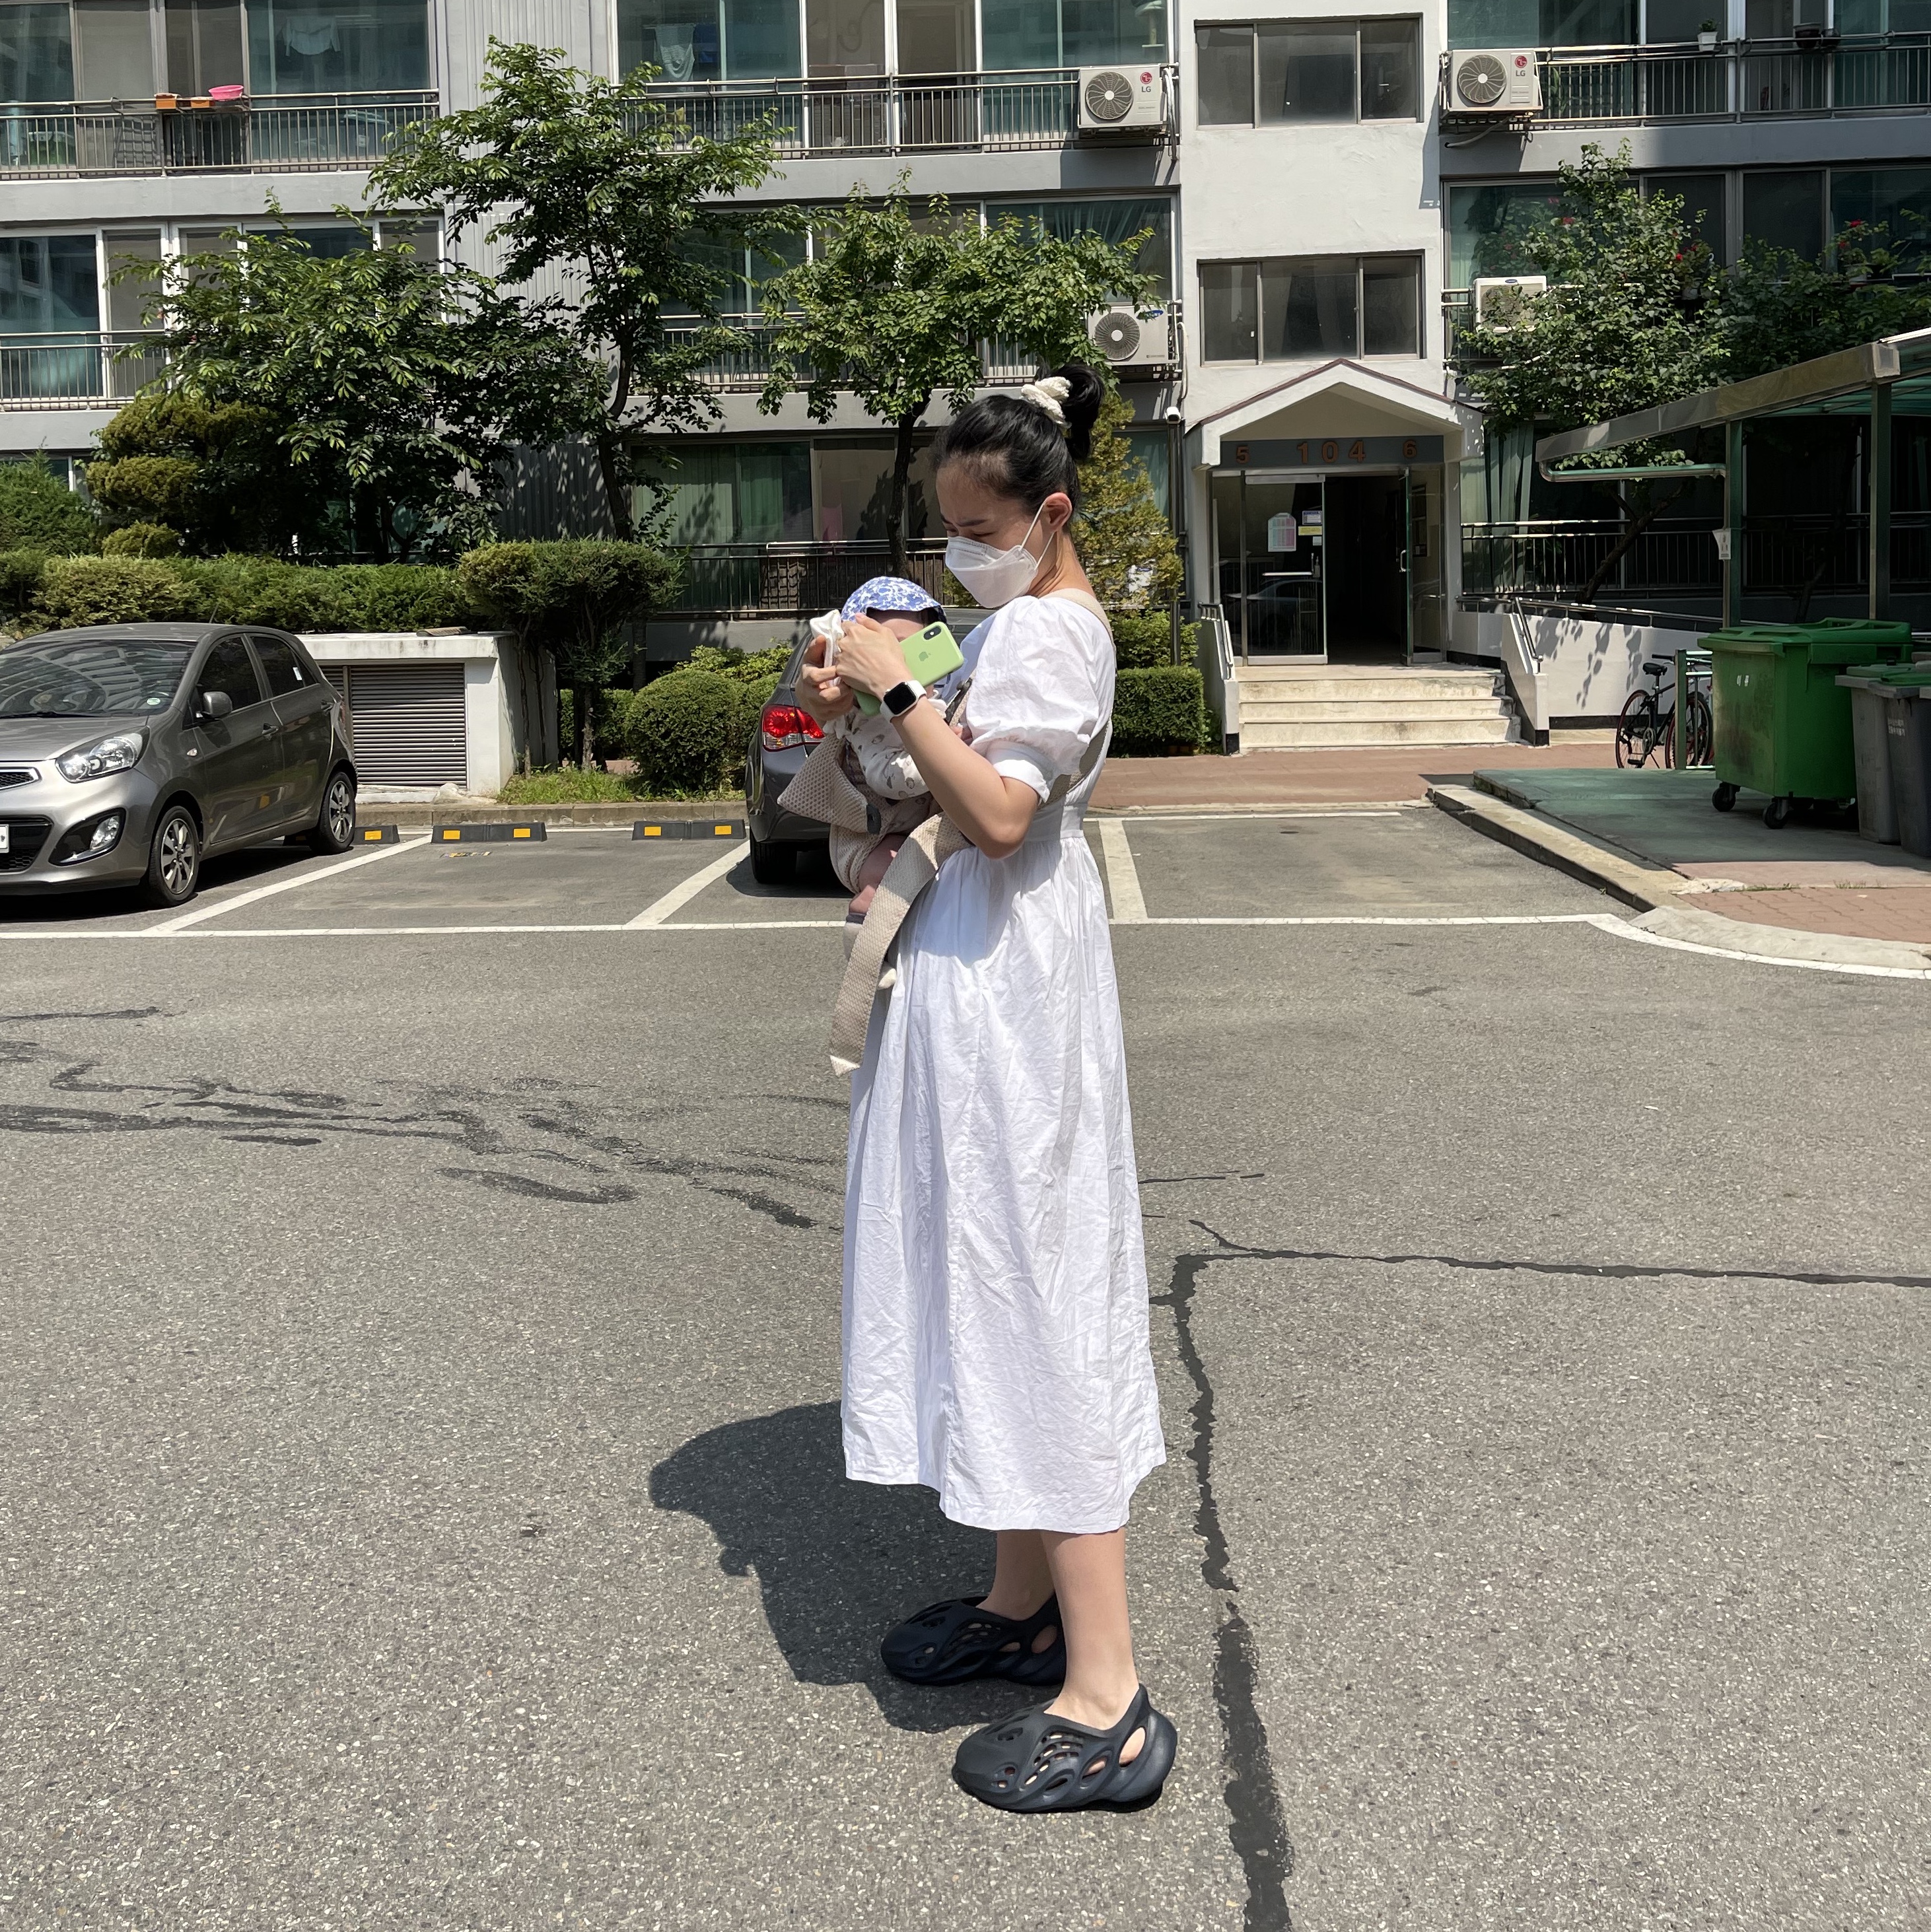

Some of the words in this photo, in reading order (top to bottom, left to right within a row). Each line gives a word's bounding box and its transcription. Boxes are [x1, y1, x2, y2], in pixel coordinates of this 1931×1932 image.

[1236, 445, 1249, 464] 5
[1297, 440, 1366, 464] 104
[1403, 439, 1417, 458] 6
